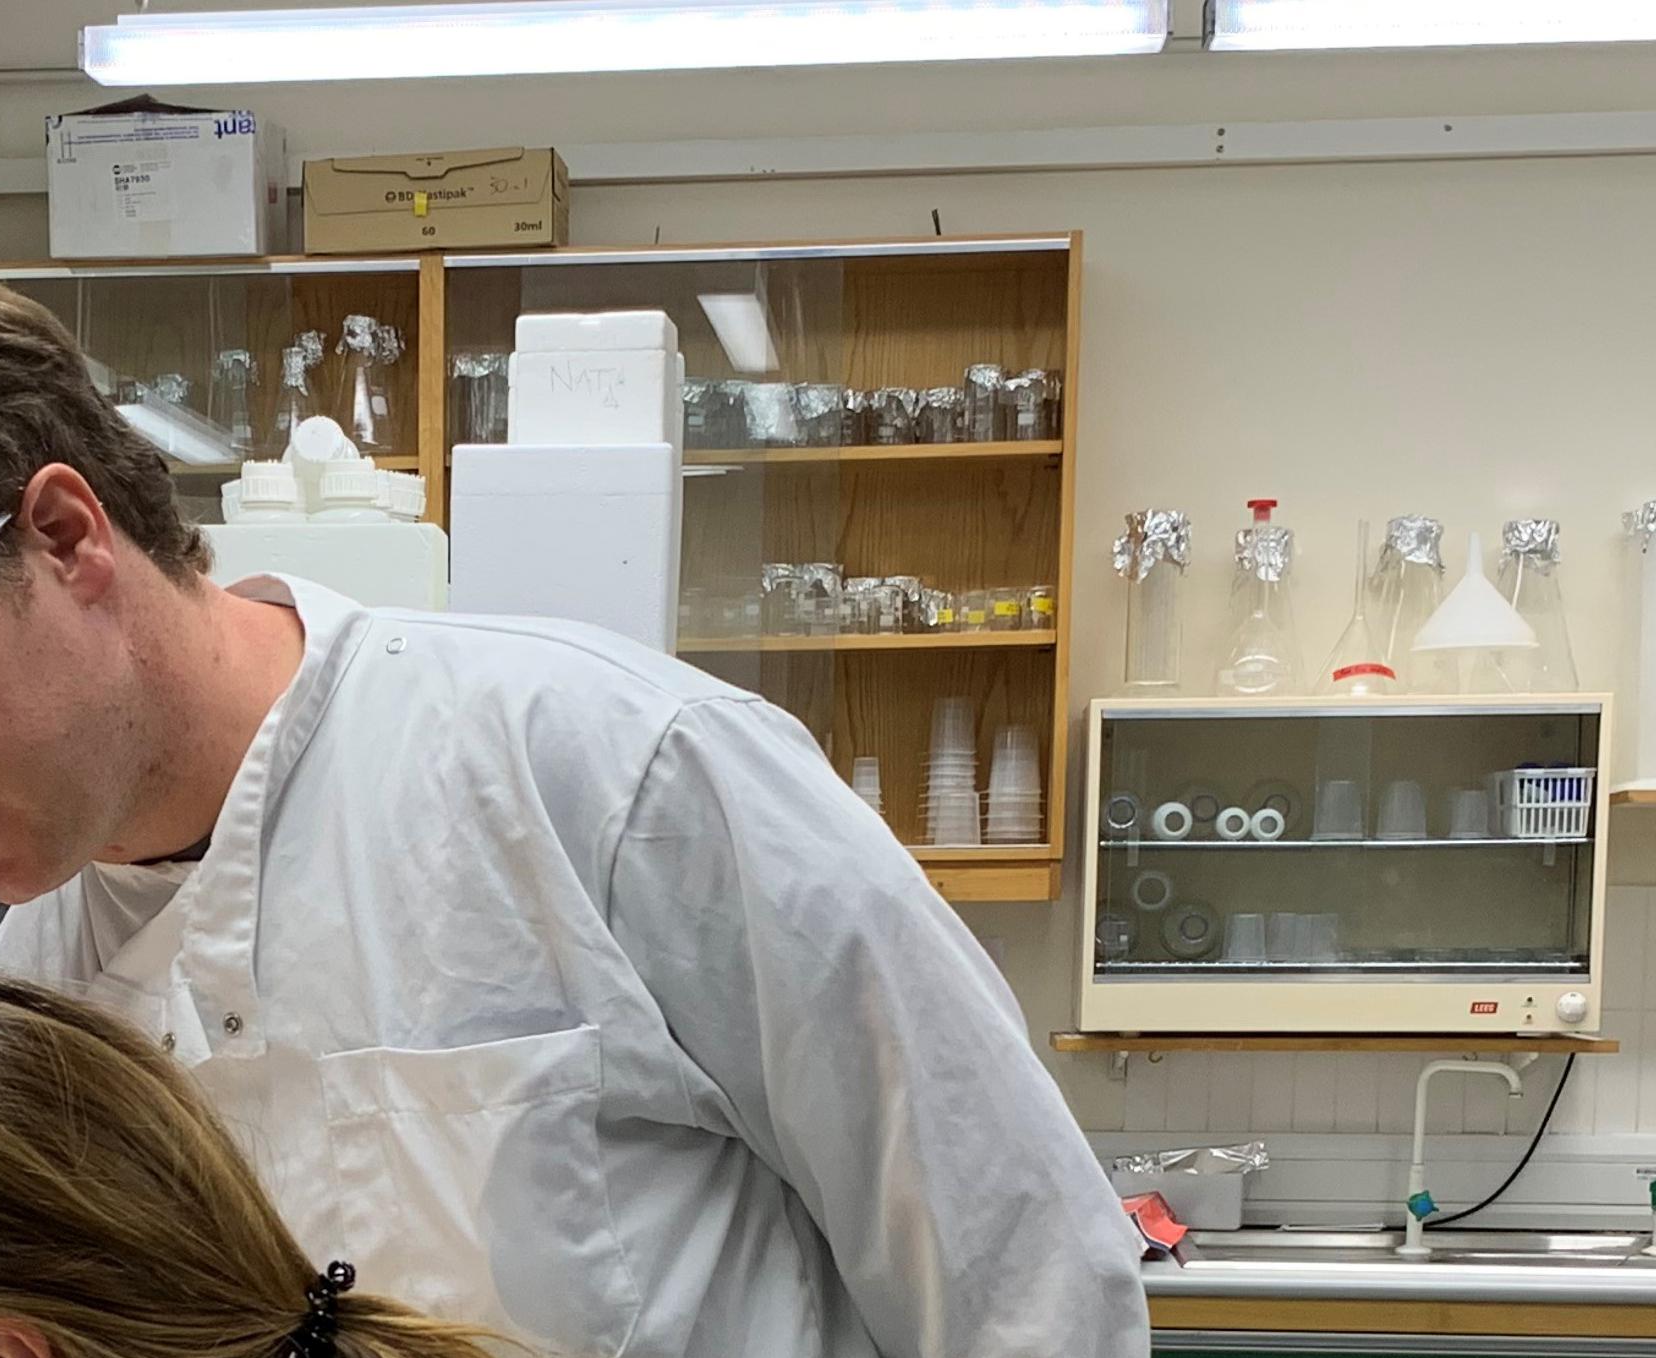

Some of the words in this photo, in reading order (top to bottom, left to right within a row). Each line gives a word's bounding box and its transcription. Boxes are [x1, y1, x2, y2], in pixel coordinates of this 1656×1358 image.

[398, 191, 415, 201] BD
[421, 226, 436, 236] 60
[514, 220, 543, 232] 30ml
